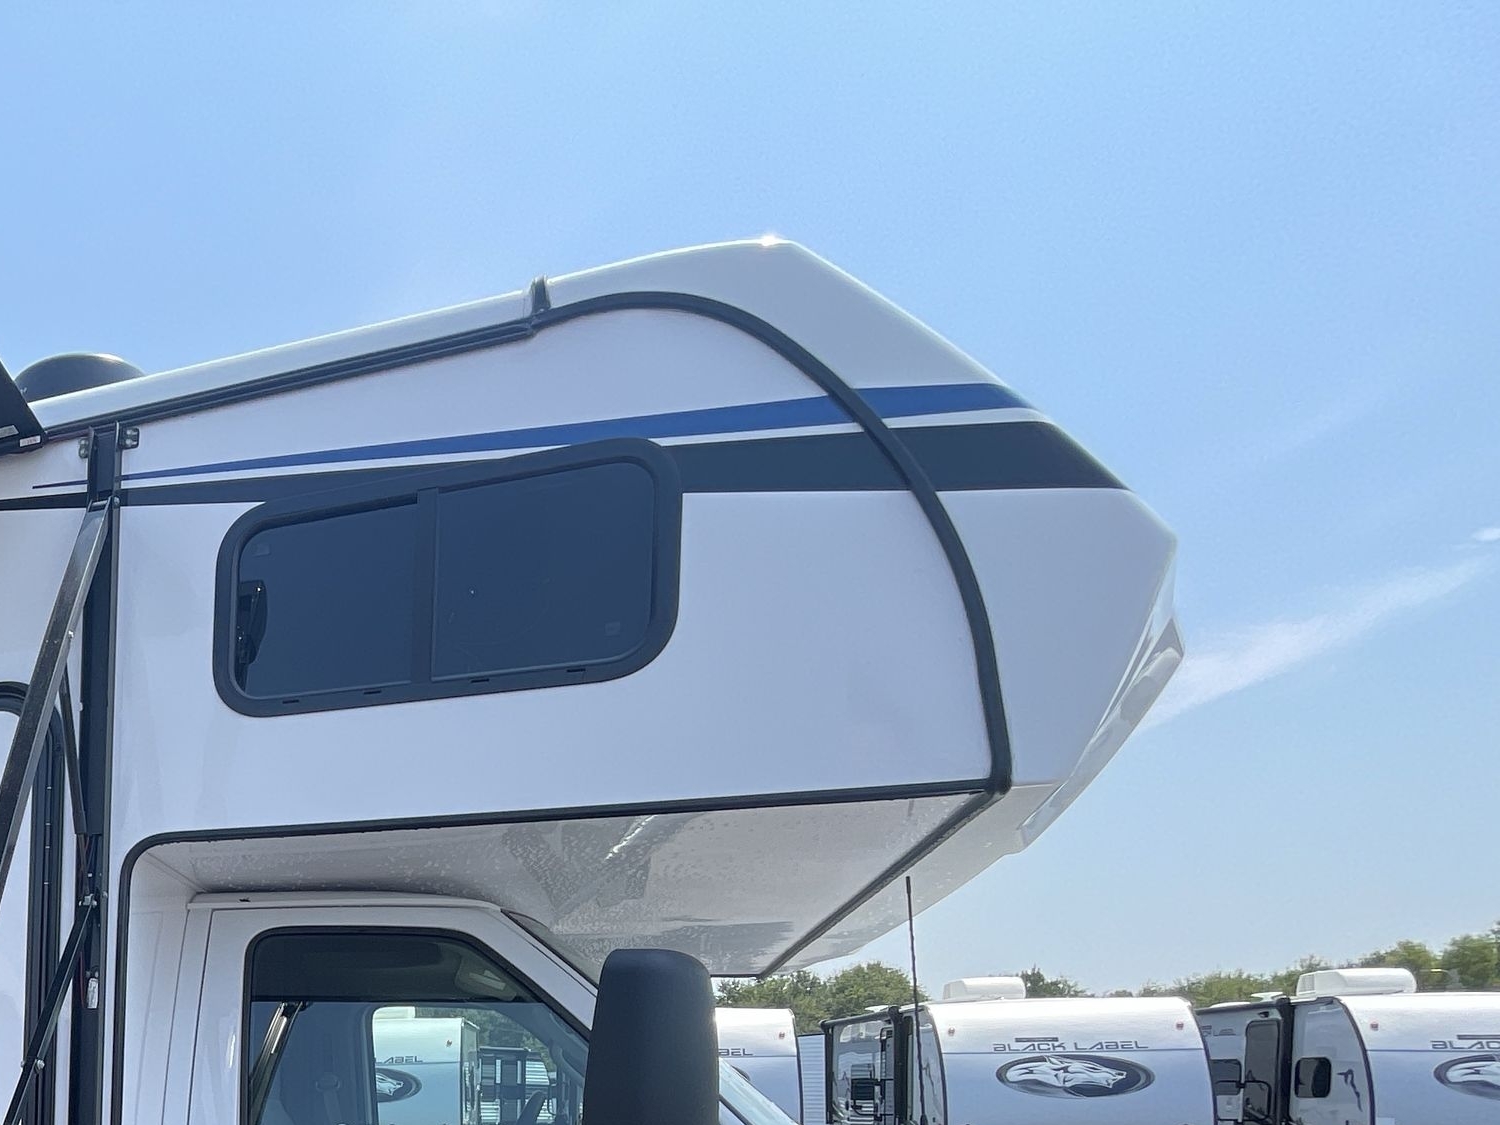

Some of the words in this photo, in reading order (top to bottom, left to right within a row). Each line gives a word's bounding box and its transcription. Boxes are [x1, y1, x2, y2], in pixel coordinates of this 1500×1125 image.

[993, 1042, 1067, 1052] BLACK
[1074, 1040, 1149, 1050] LABEL
[1430, 1040, 1500, 1049] BLAC
[718, 1048, 753, 1056] BEL
